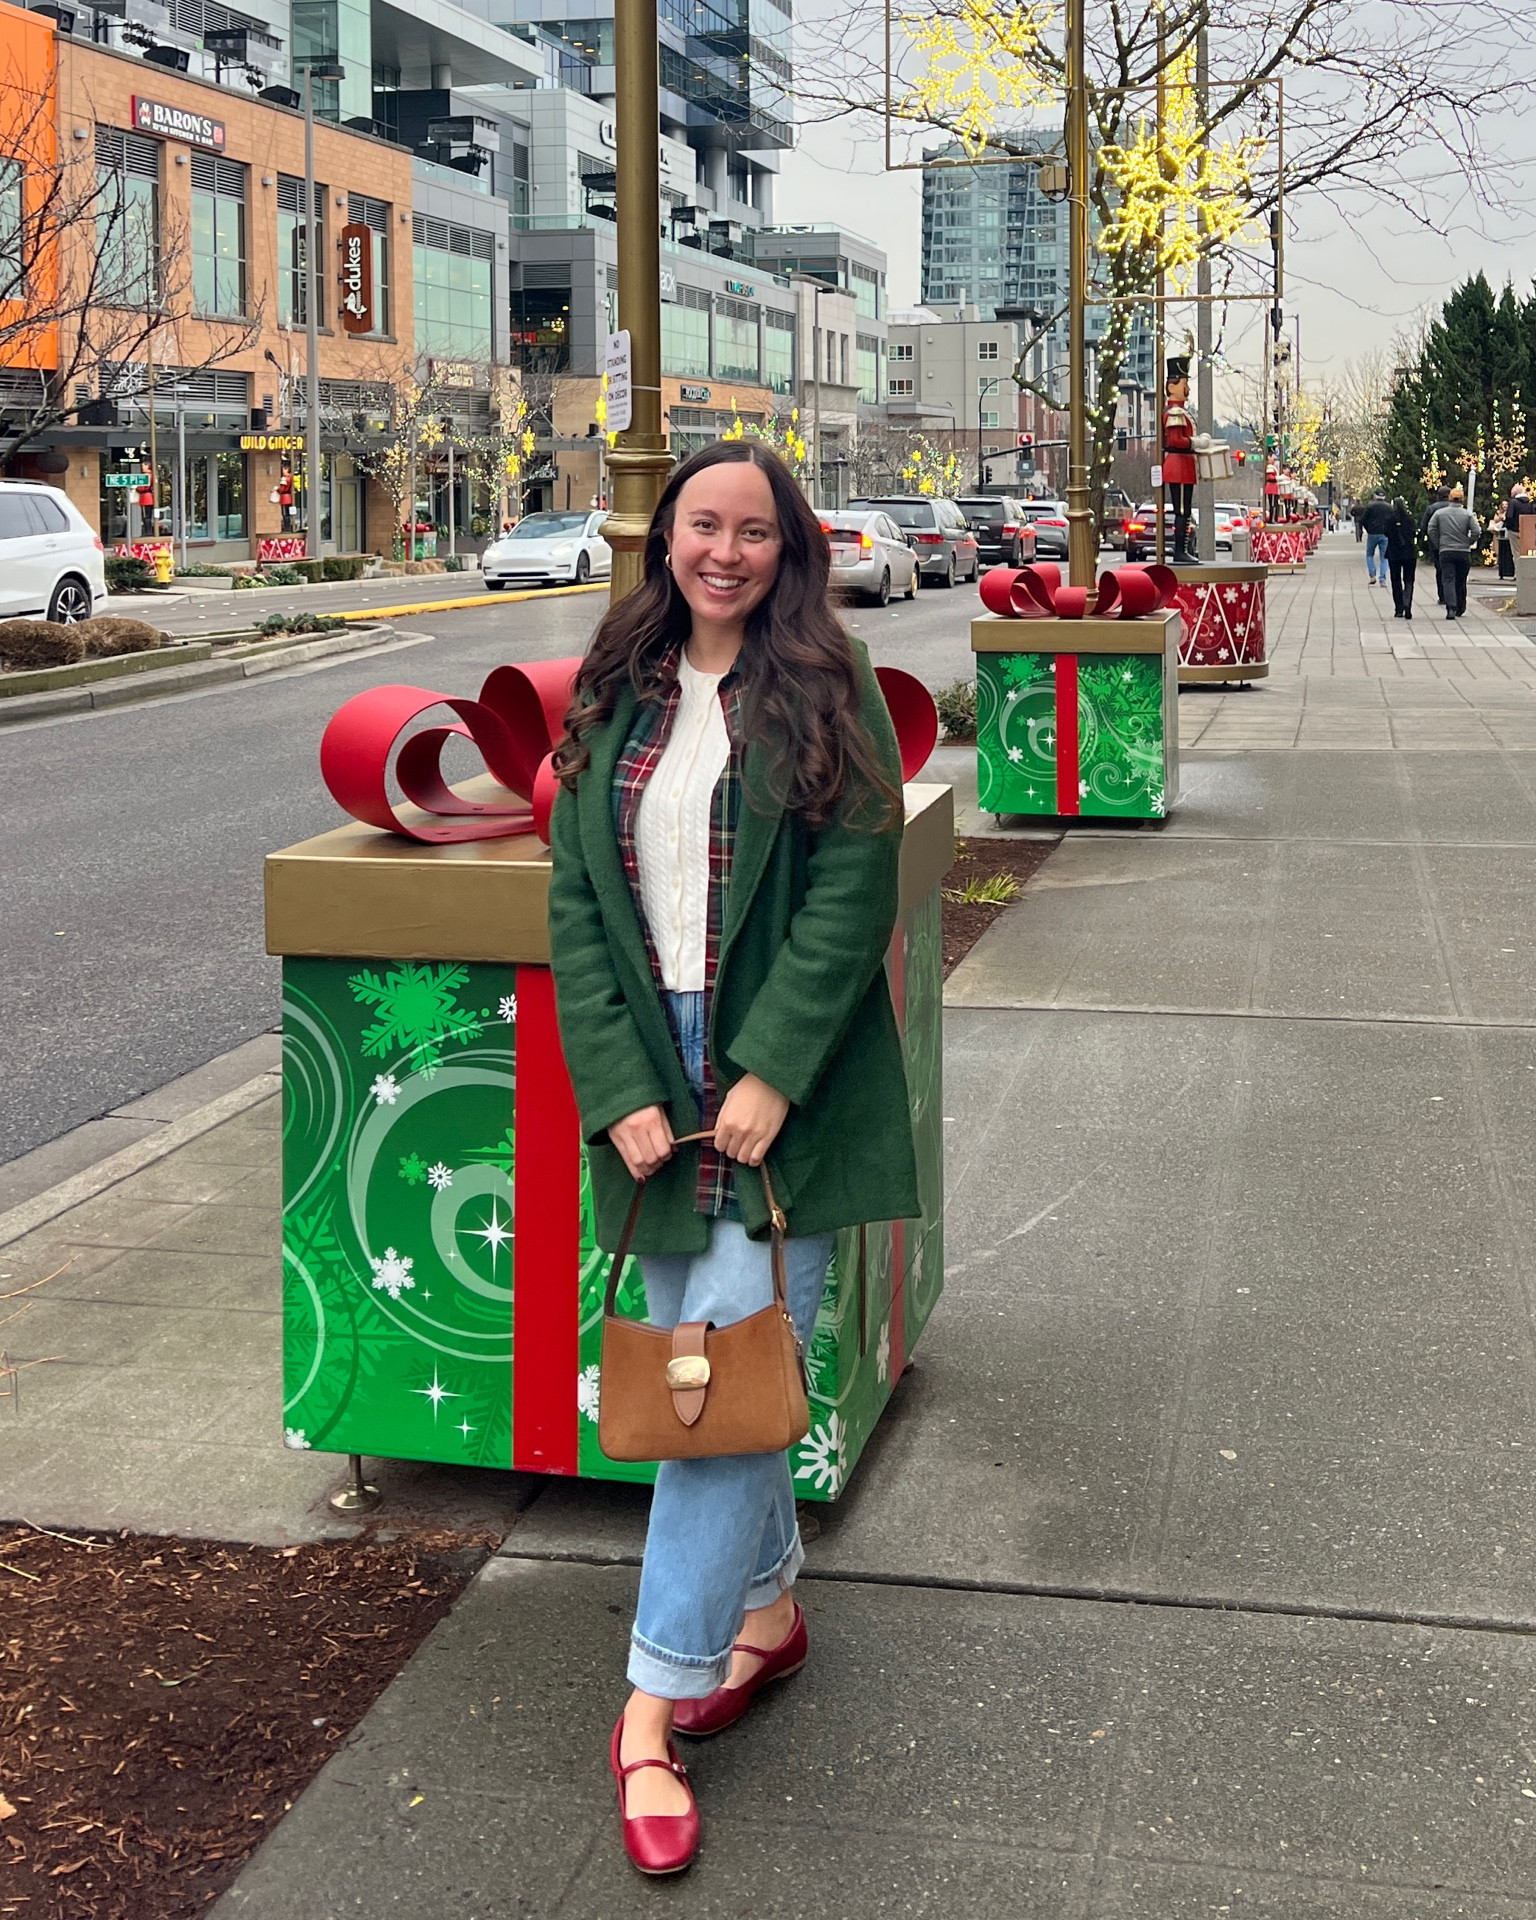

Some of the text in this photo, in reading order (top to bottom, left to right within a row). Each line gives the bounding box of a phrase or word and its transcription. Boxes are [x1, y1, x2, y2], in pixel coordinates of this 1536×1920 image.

[154, 104, 212, 136] BARON'S
[169, 127, 194, 140] KITCHEN
[195, 134, 200, 142] &
[201, 136, 213, 146] BAR
[343, 236, 361, 291] dukes
[614, 340, 620, 349] NO
[607, 354, 627, 369] STANDING
[240, 436, 303, 450] WILD GINGER
[109, 475, 120, 485] NE
[121, 475, 128, 485] 5
